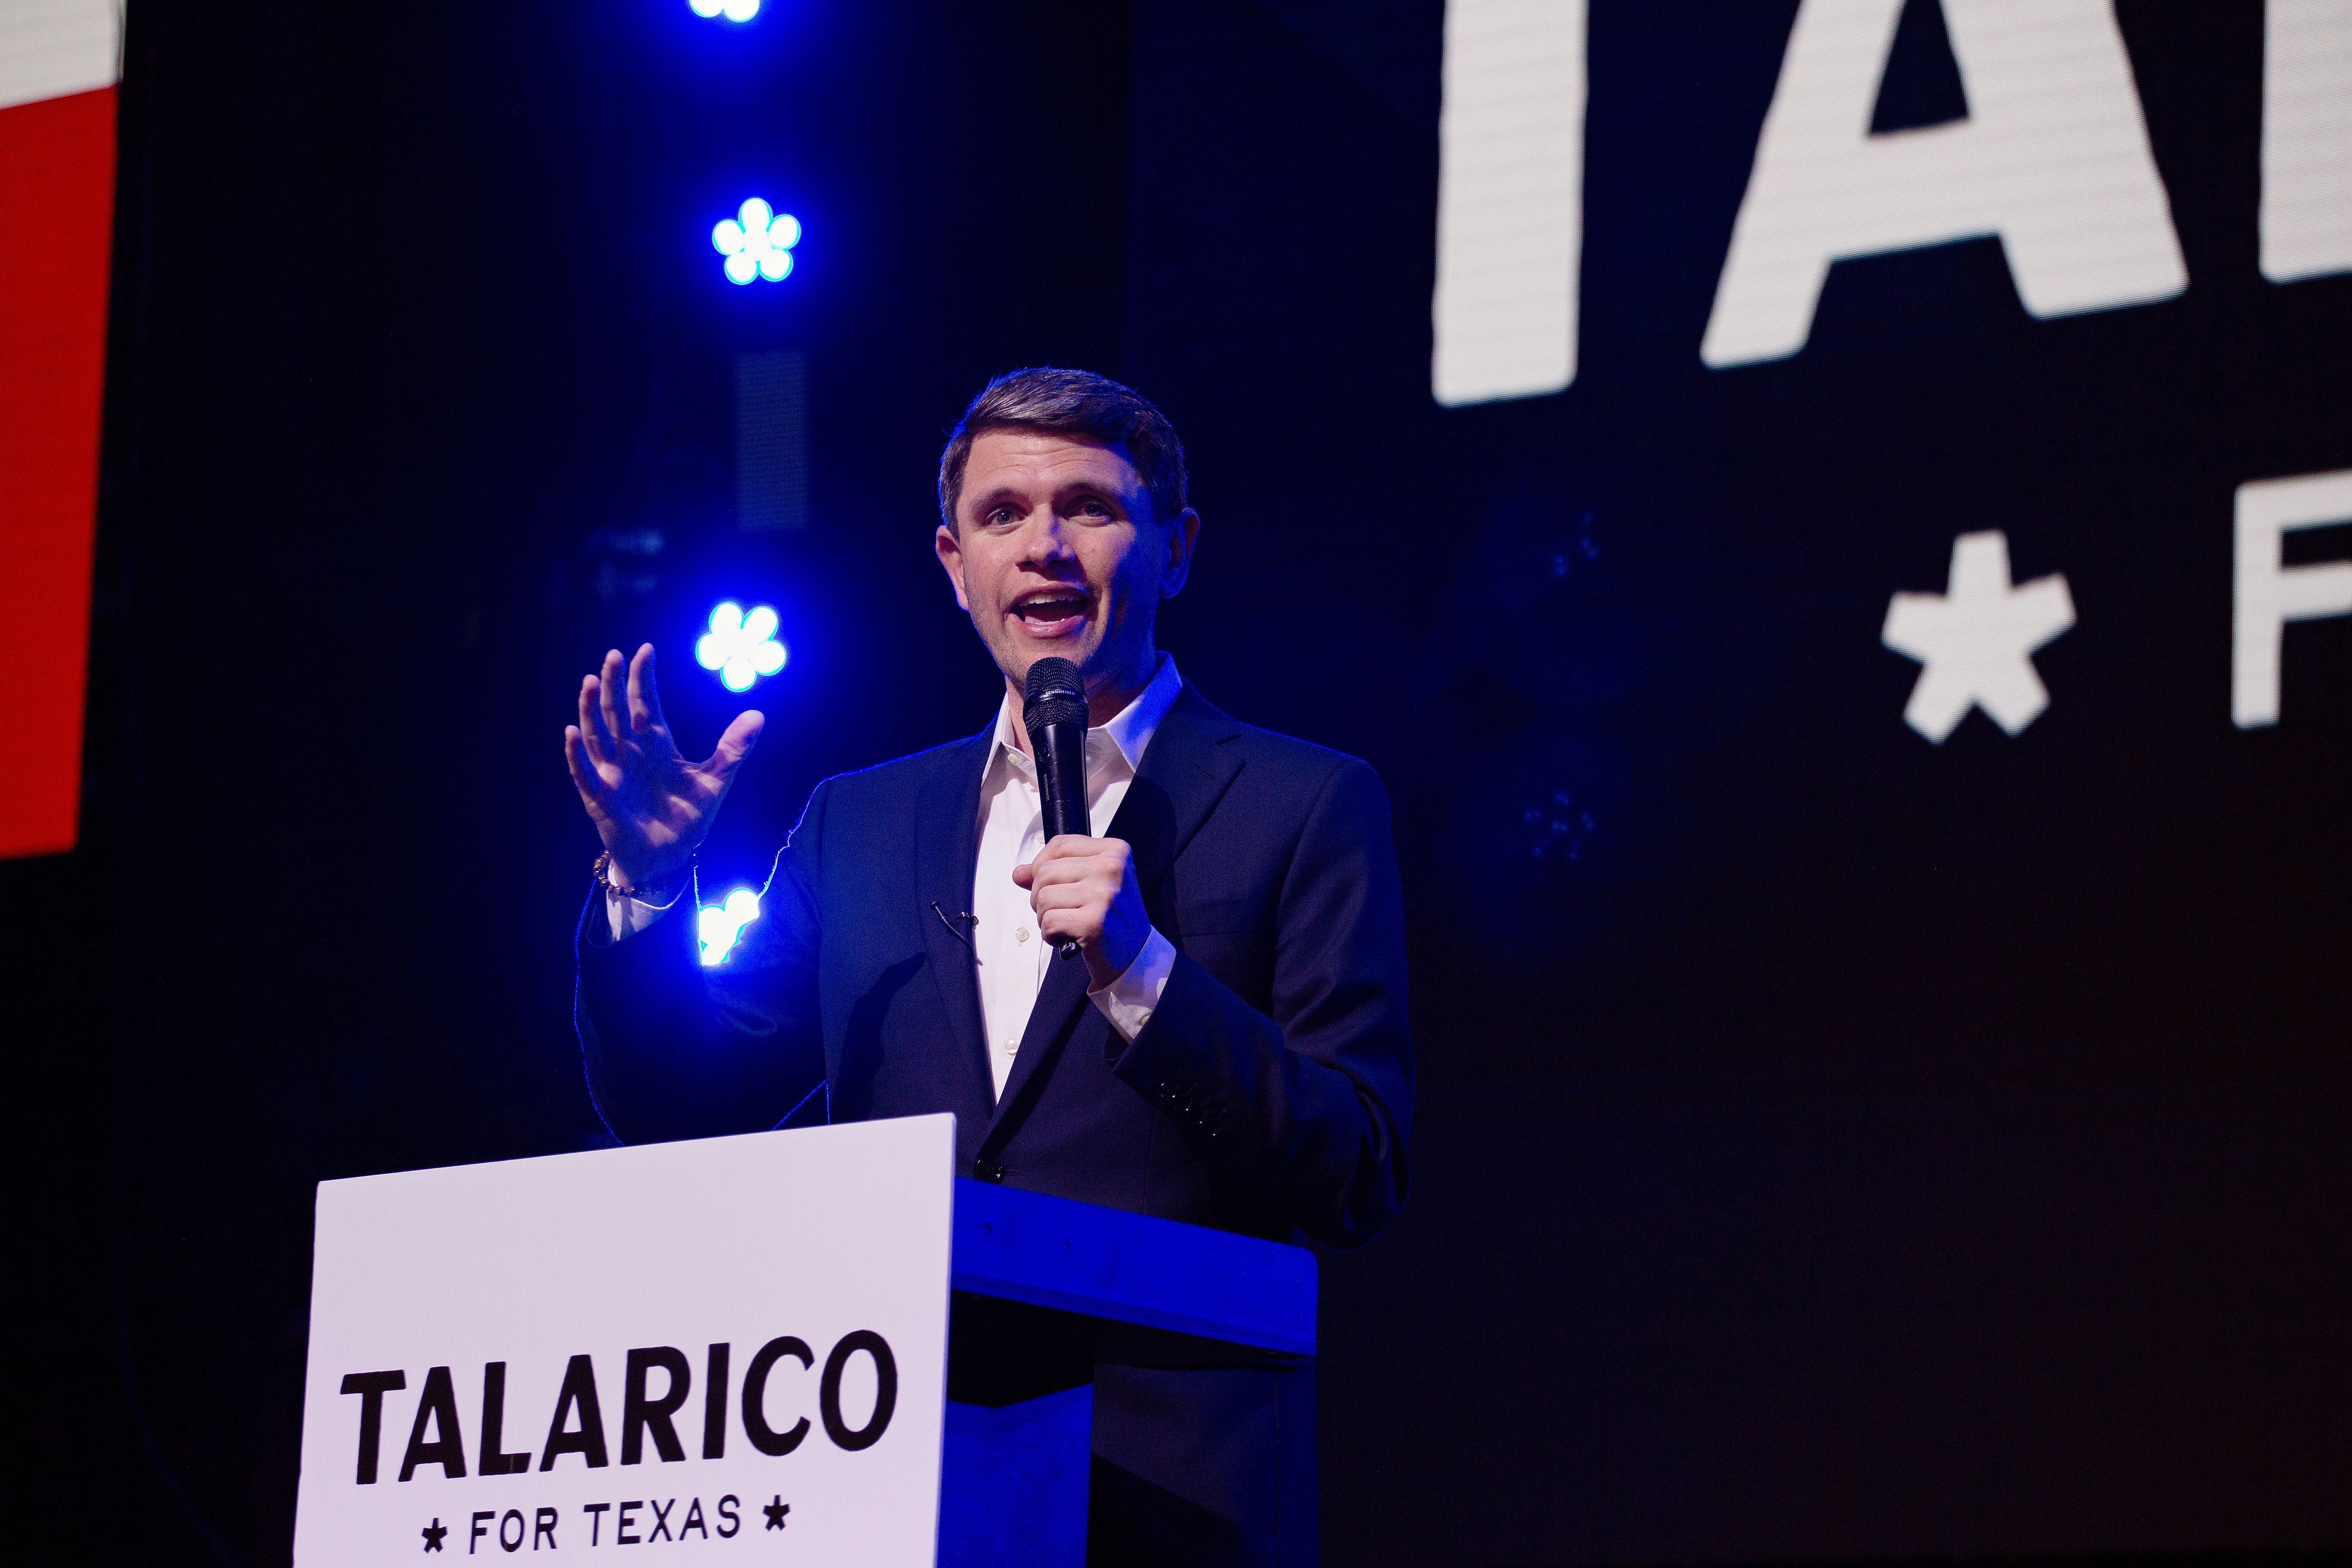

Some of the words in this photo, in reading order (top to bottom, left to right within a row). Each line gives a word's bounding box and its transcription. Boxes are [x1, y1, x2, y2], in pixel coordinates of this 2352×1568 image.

[339, 1329, 898, 1485] TALARICO
[469, 1507, 558, 1555] FOR
[583, 1494, 741, 1547] TEXAS
